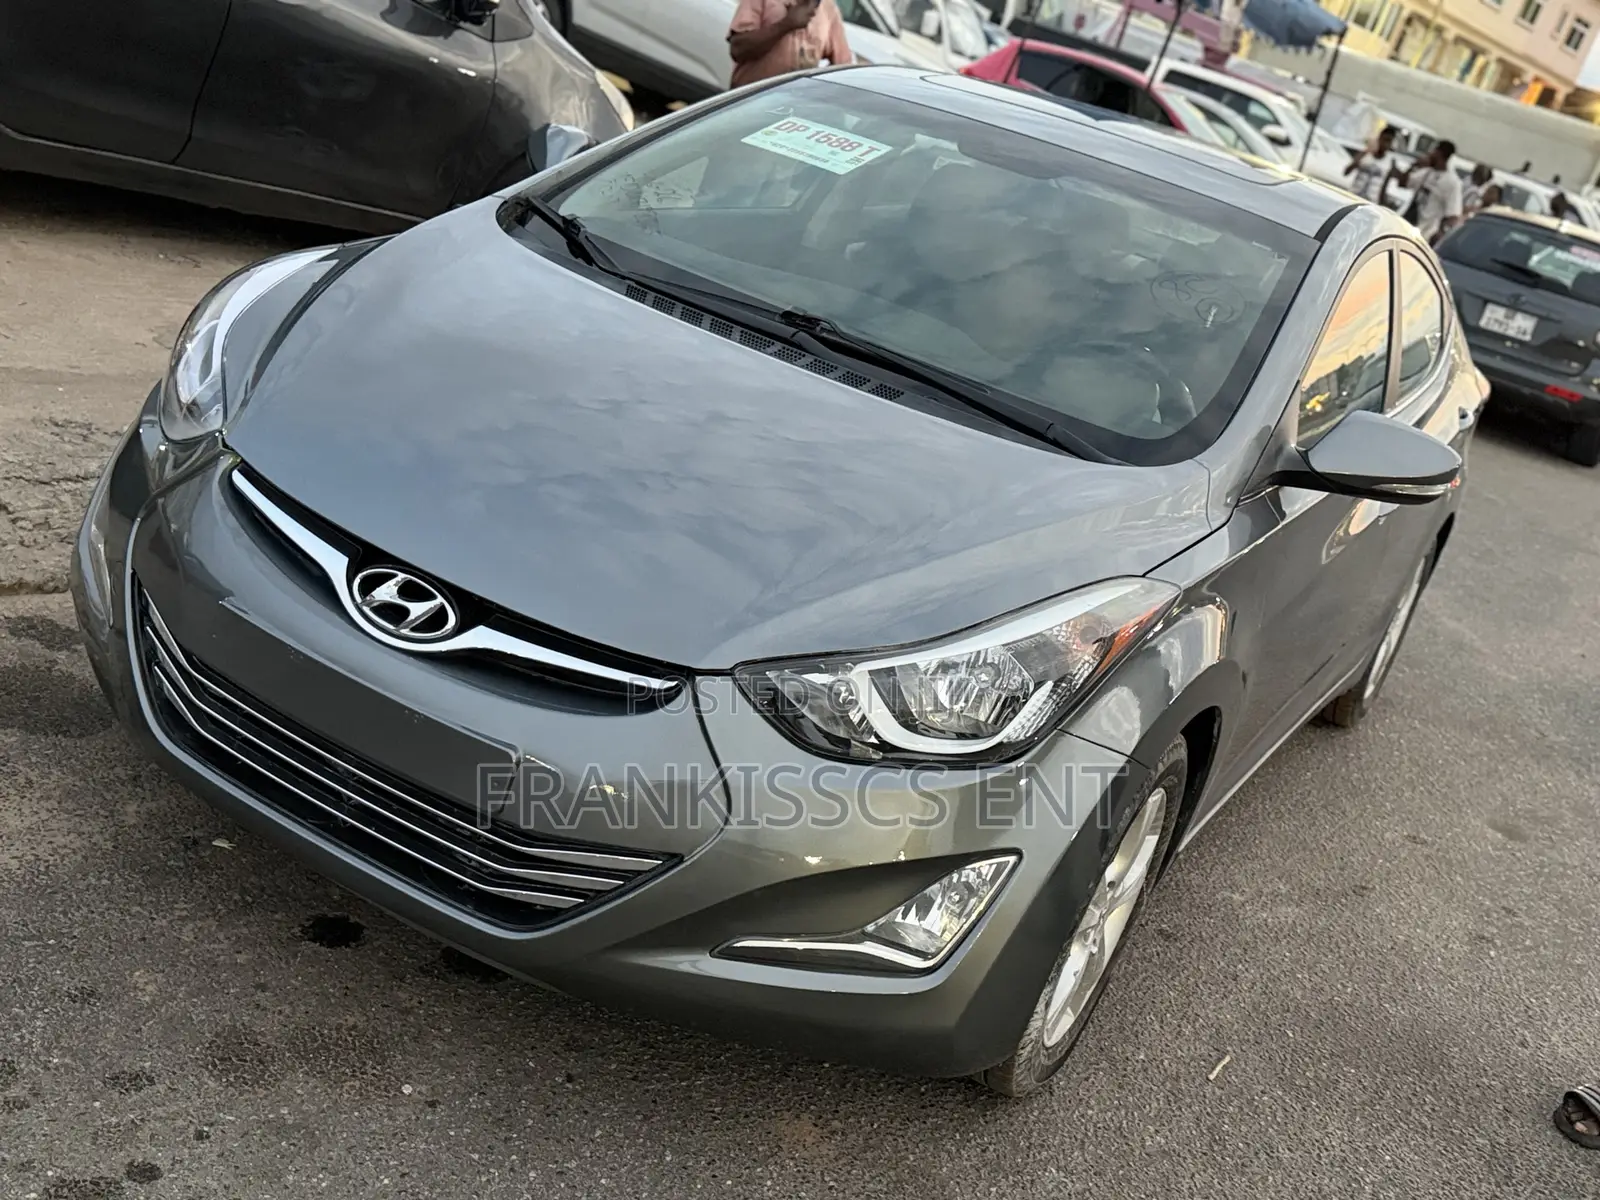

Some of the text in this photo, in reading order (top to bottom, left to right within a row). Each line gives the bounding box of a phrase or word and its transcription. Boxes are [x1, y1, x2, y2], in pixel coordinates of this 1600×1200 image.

[773, 120, 880, 157] DP 1588 T
